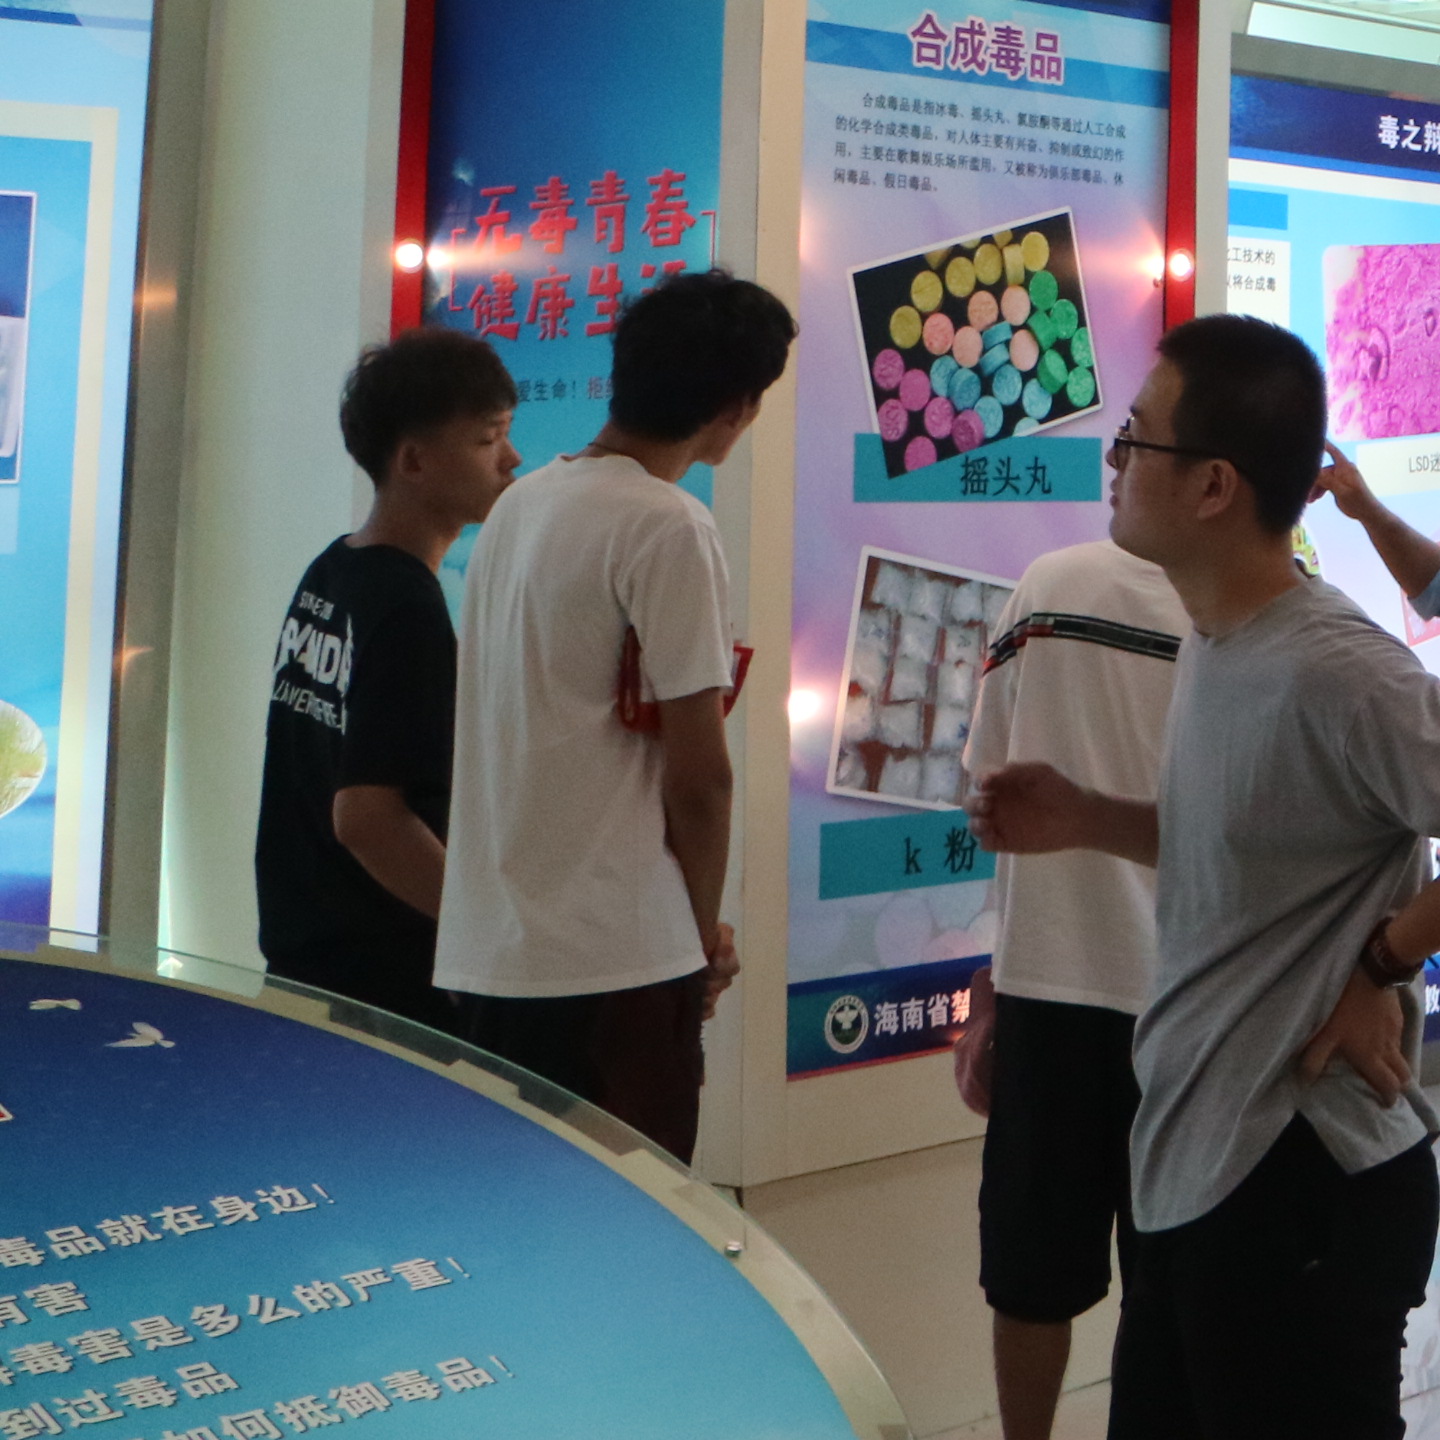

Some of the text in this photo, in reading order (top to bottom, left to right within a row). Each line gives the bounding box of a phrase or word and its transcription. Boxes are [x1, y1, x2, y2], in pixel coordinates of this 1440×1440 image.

[910, 12, 1065, 85] 合成毒品
[473, 168, 697, 254] 无毒青春
[961, 456, 1052, 497] 摇头丸
[0, 1182, 336, 1268] 毒品就在身边！
[0, 1256, 471, 1386] 毒害是多么的严重！
